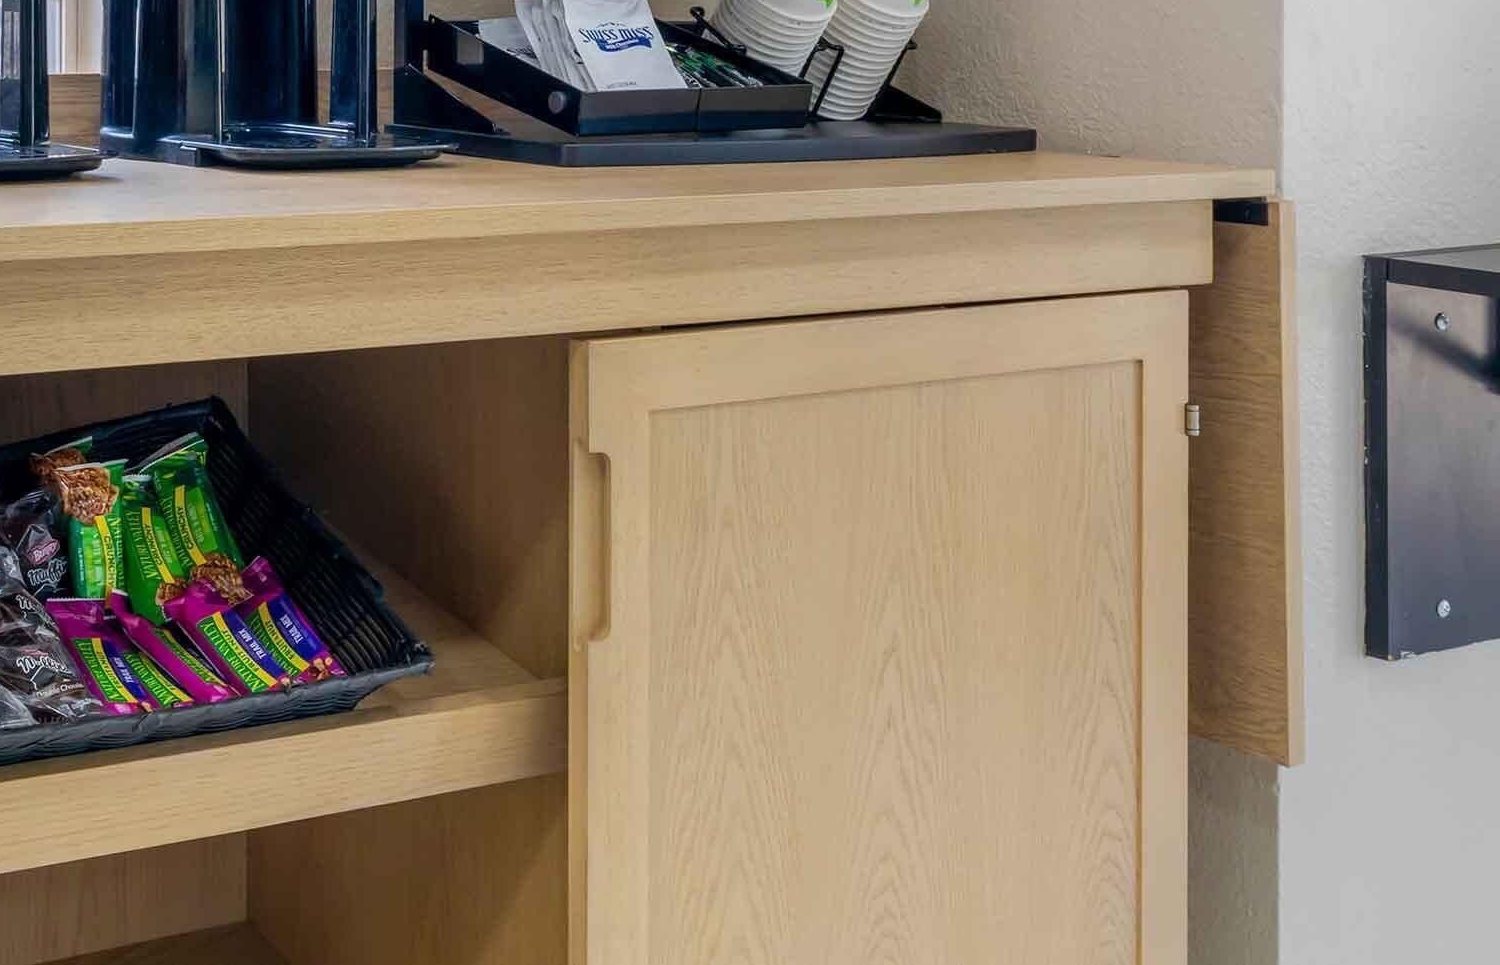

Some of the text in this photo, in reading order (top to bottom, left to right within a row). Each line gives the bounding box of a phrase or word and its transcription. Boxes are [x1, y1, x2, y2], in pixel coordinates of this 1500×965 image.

[177, 507, 193, 549] CRUNCHY
[144, 524, 162, 566] CRUNCHY
[103, 535, 116, 588] CRUNCHY
[263, 620, 277, 637] NUT
[279, 614, 292, 627] MIX
[222, 629, 236, 646] NUT
[238, 628, 251, 642] MIX
[201, 620, 263, 693] NATURE VALLEY
[276, 638, 294, 660] FRUIT
[238, 649, 258, 674] FRUIT
